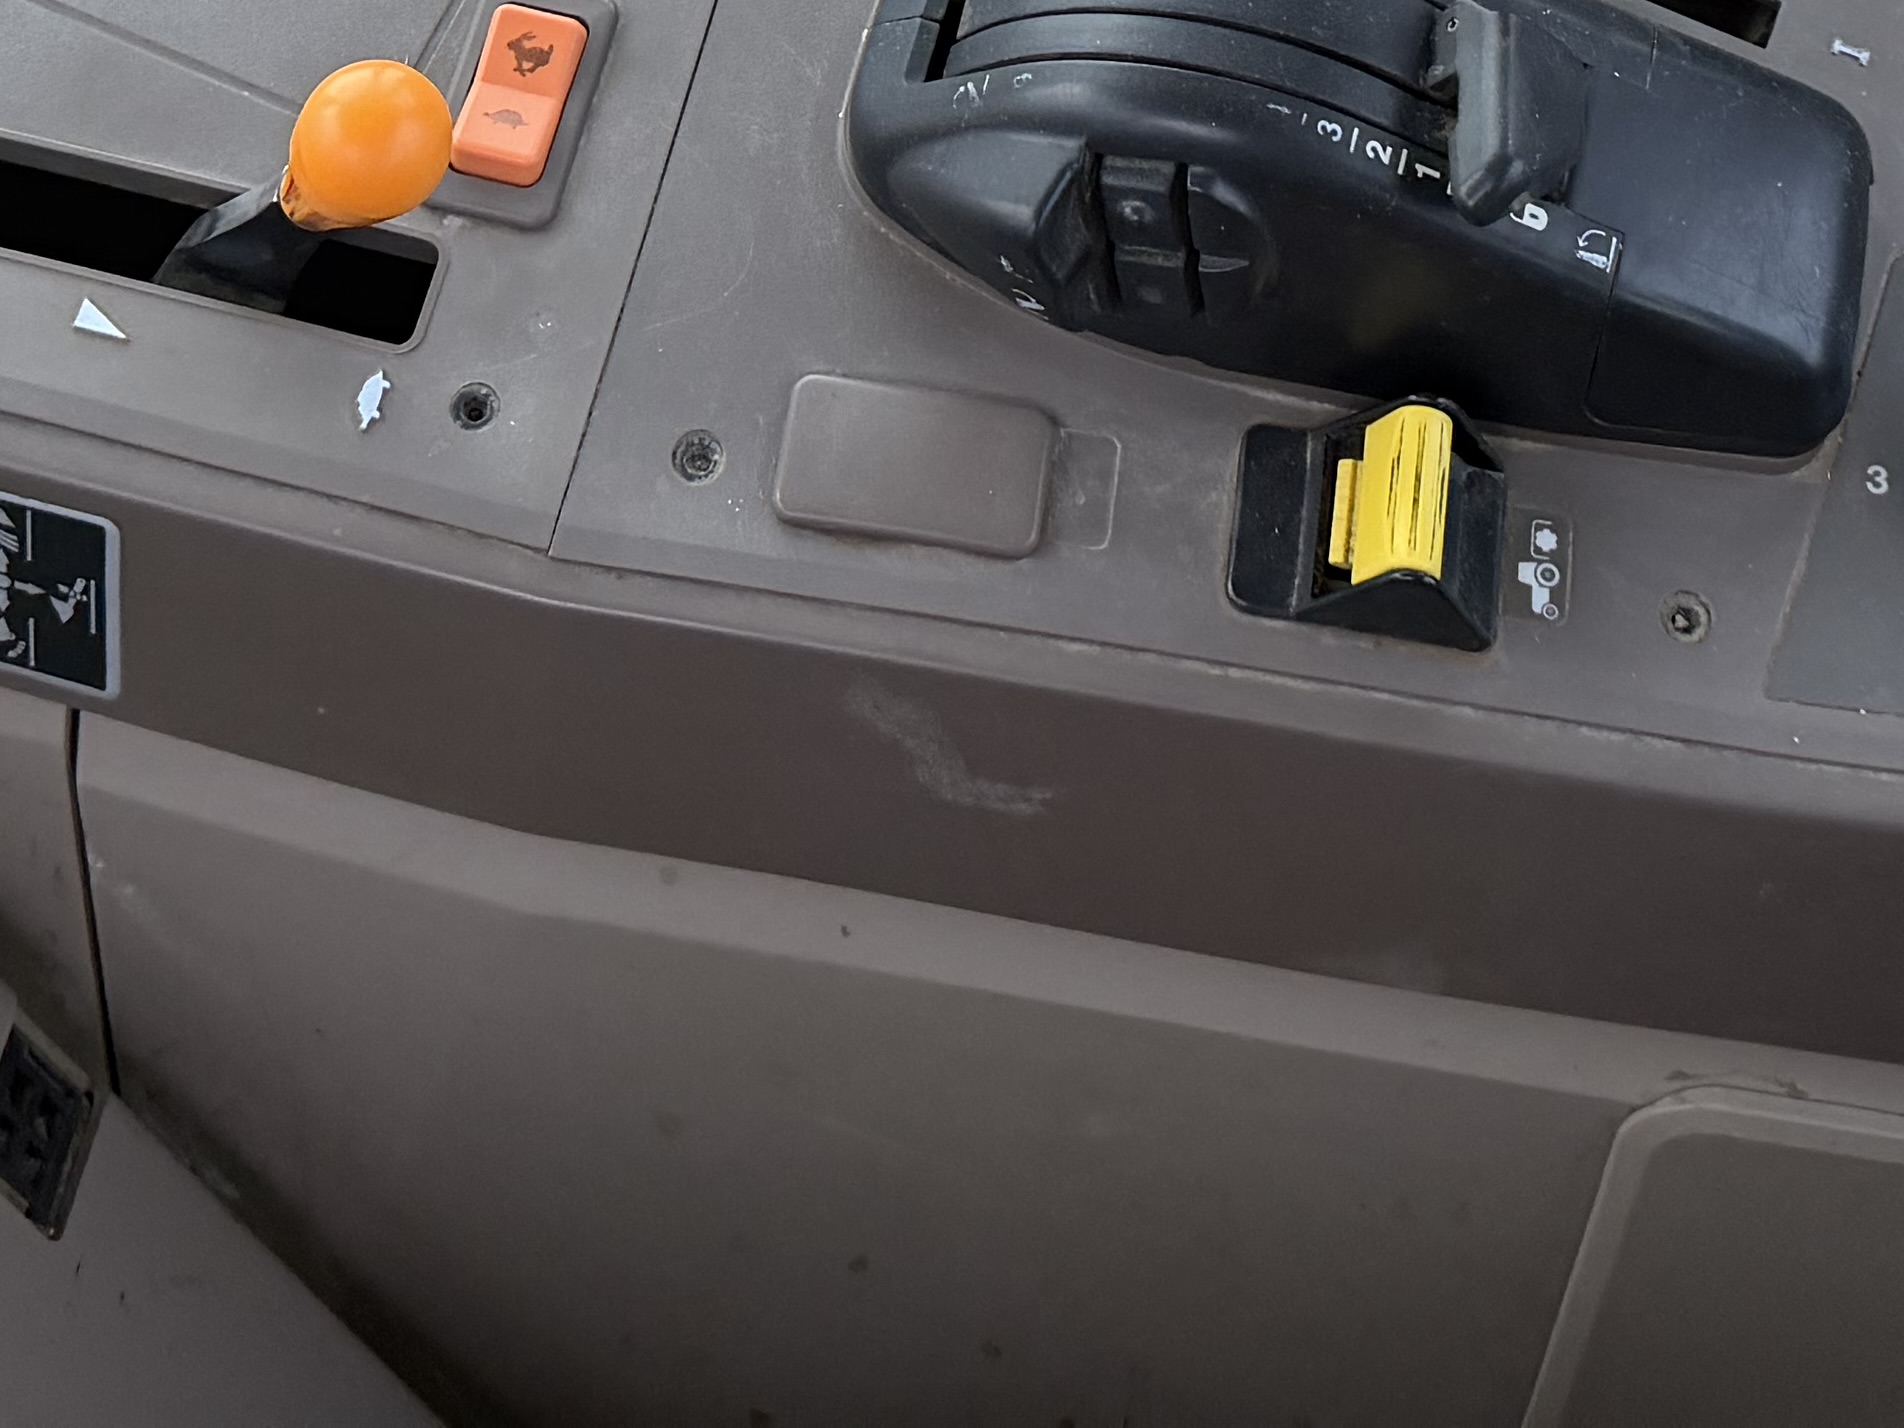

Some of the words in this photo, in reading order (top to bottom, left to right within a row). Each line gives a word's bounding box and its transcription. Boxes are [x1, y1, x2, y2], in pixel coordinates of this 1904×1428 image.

[1317, 119, 1343, 142] 3
[1366, 140, 1393, 165] 2
[1415, 162, 1441, 179] 1
[1865, 465, 1890, 495] 3
